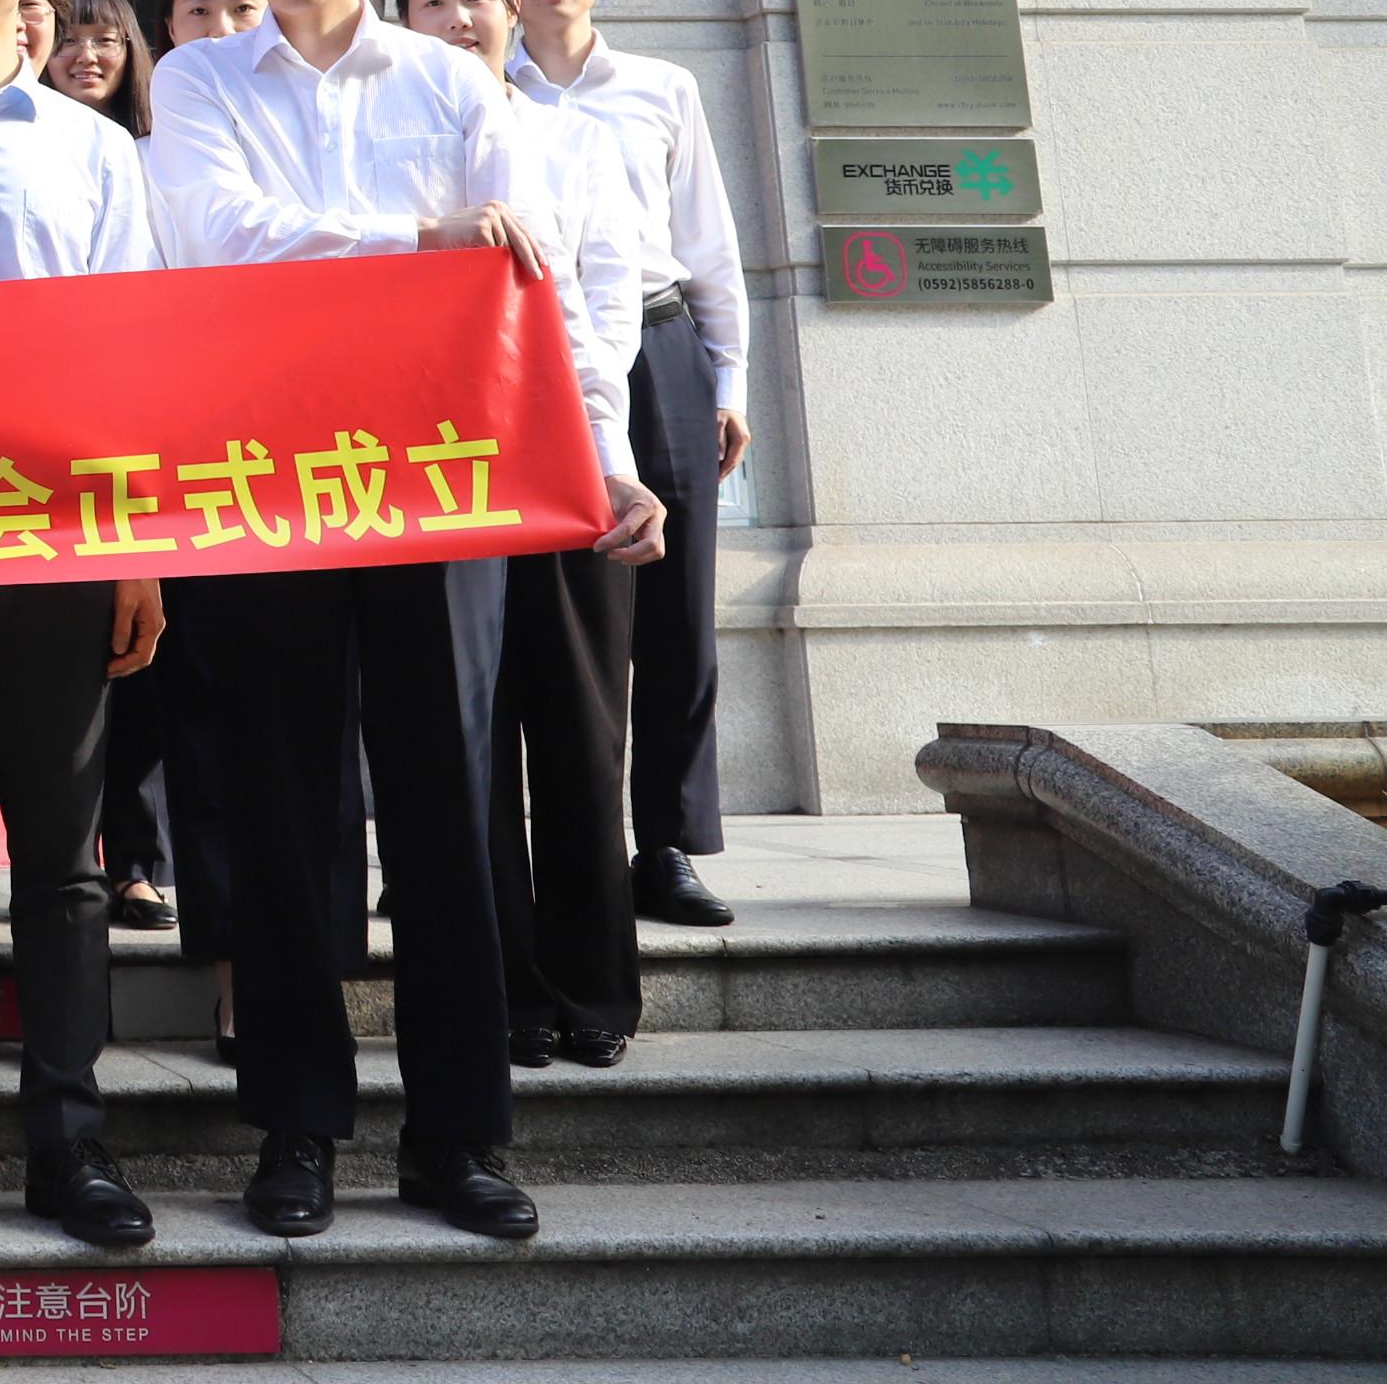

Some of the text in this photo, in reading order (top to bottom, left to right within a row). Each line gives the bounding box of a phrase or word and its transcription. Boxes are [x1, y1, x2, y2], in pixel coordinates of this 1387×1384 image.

[843, 164, 951, 178] EXCHANGE
[884, 179, 954, 196] 货币兑换
[915, 238, 1030, 254] 无障碍服务热线
[918, 260, 1031, 273] Accessibility Services
[917, 278, 1035, 292] (0592)5856288-0
[0, 1327, 149, 1342] MIND THE STEP
